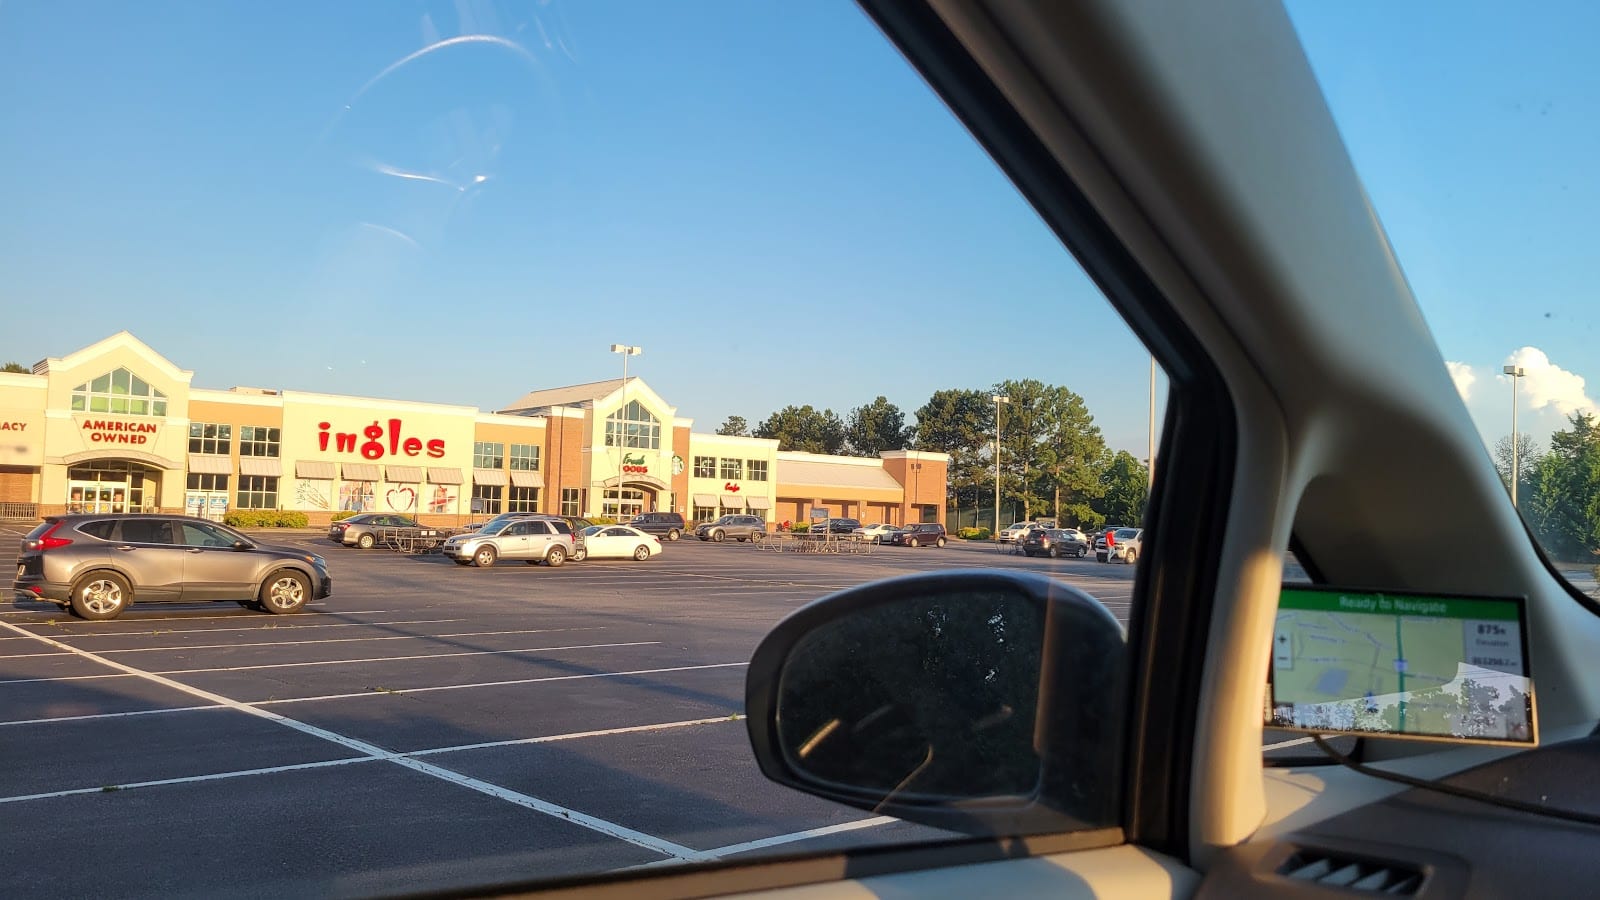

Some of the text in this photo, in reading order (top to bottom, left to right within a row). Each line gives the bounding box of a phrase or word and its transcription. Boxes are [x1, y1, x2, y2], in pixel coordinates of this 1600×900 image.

[0, 421, 27, 432] ACY
[82, 419, 157, 433] AMERICAN
[90, 432, 147, 445] OWNED
[317, 418, 446, 460] ingles
[622, 465, 648, 474] OODS
[1339, 596, 1447, 614] Ready to Navigate
